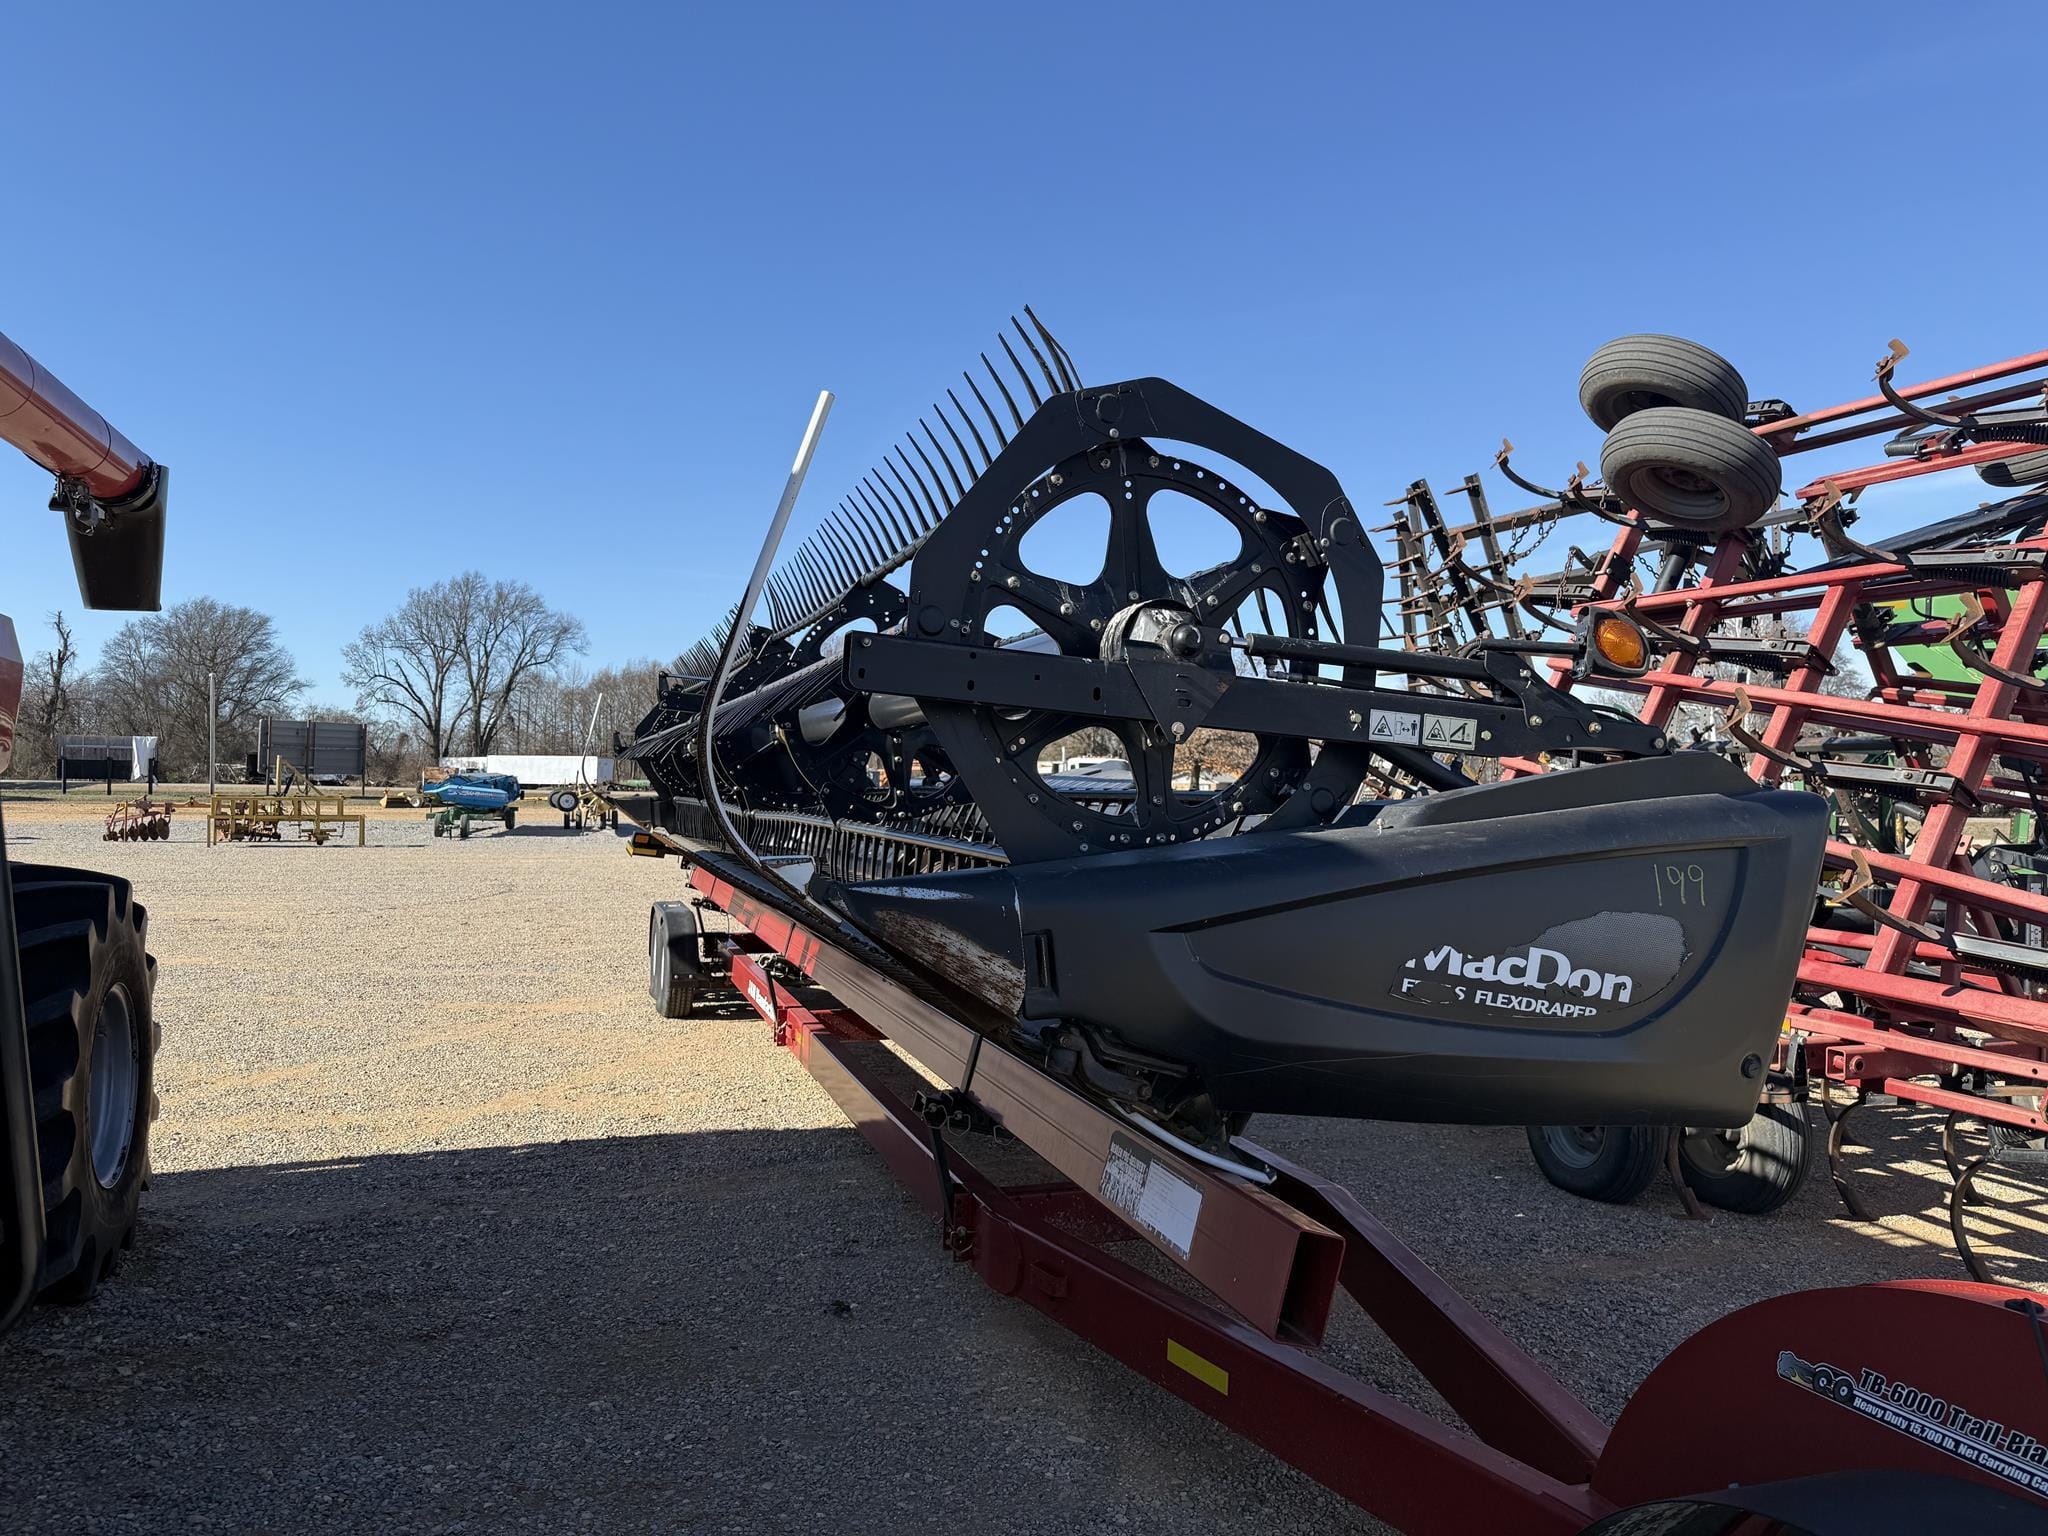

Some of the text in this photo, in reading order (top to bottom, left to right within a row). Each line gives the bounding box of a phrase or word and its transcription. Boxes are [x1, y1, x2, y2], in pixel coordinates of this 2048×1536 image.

[1653, 864, 1706, 906] 199
[1404, 944, 1633, 1004] MacDon
[1859, 1368, 1947, 1422] TB-6000
[1853, 1397, 2048, 1495] Heavy Duty 15,700 lb. Net Carrying Ca
